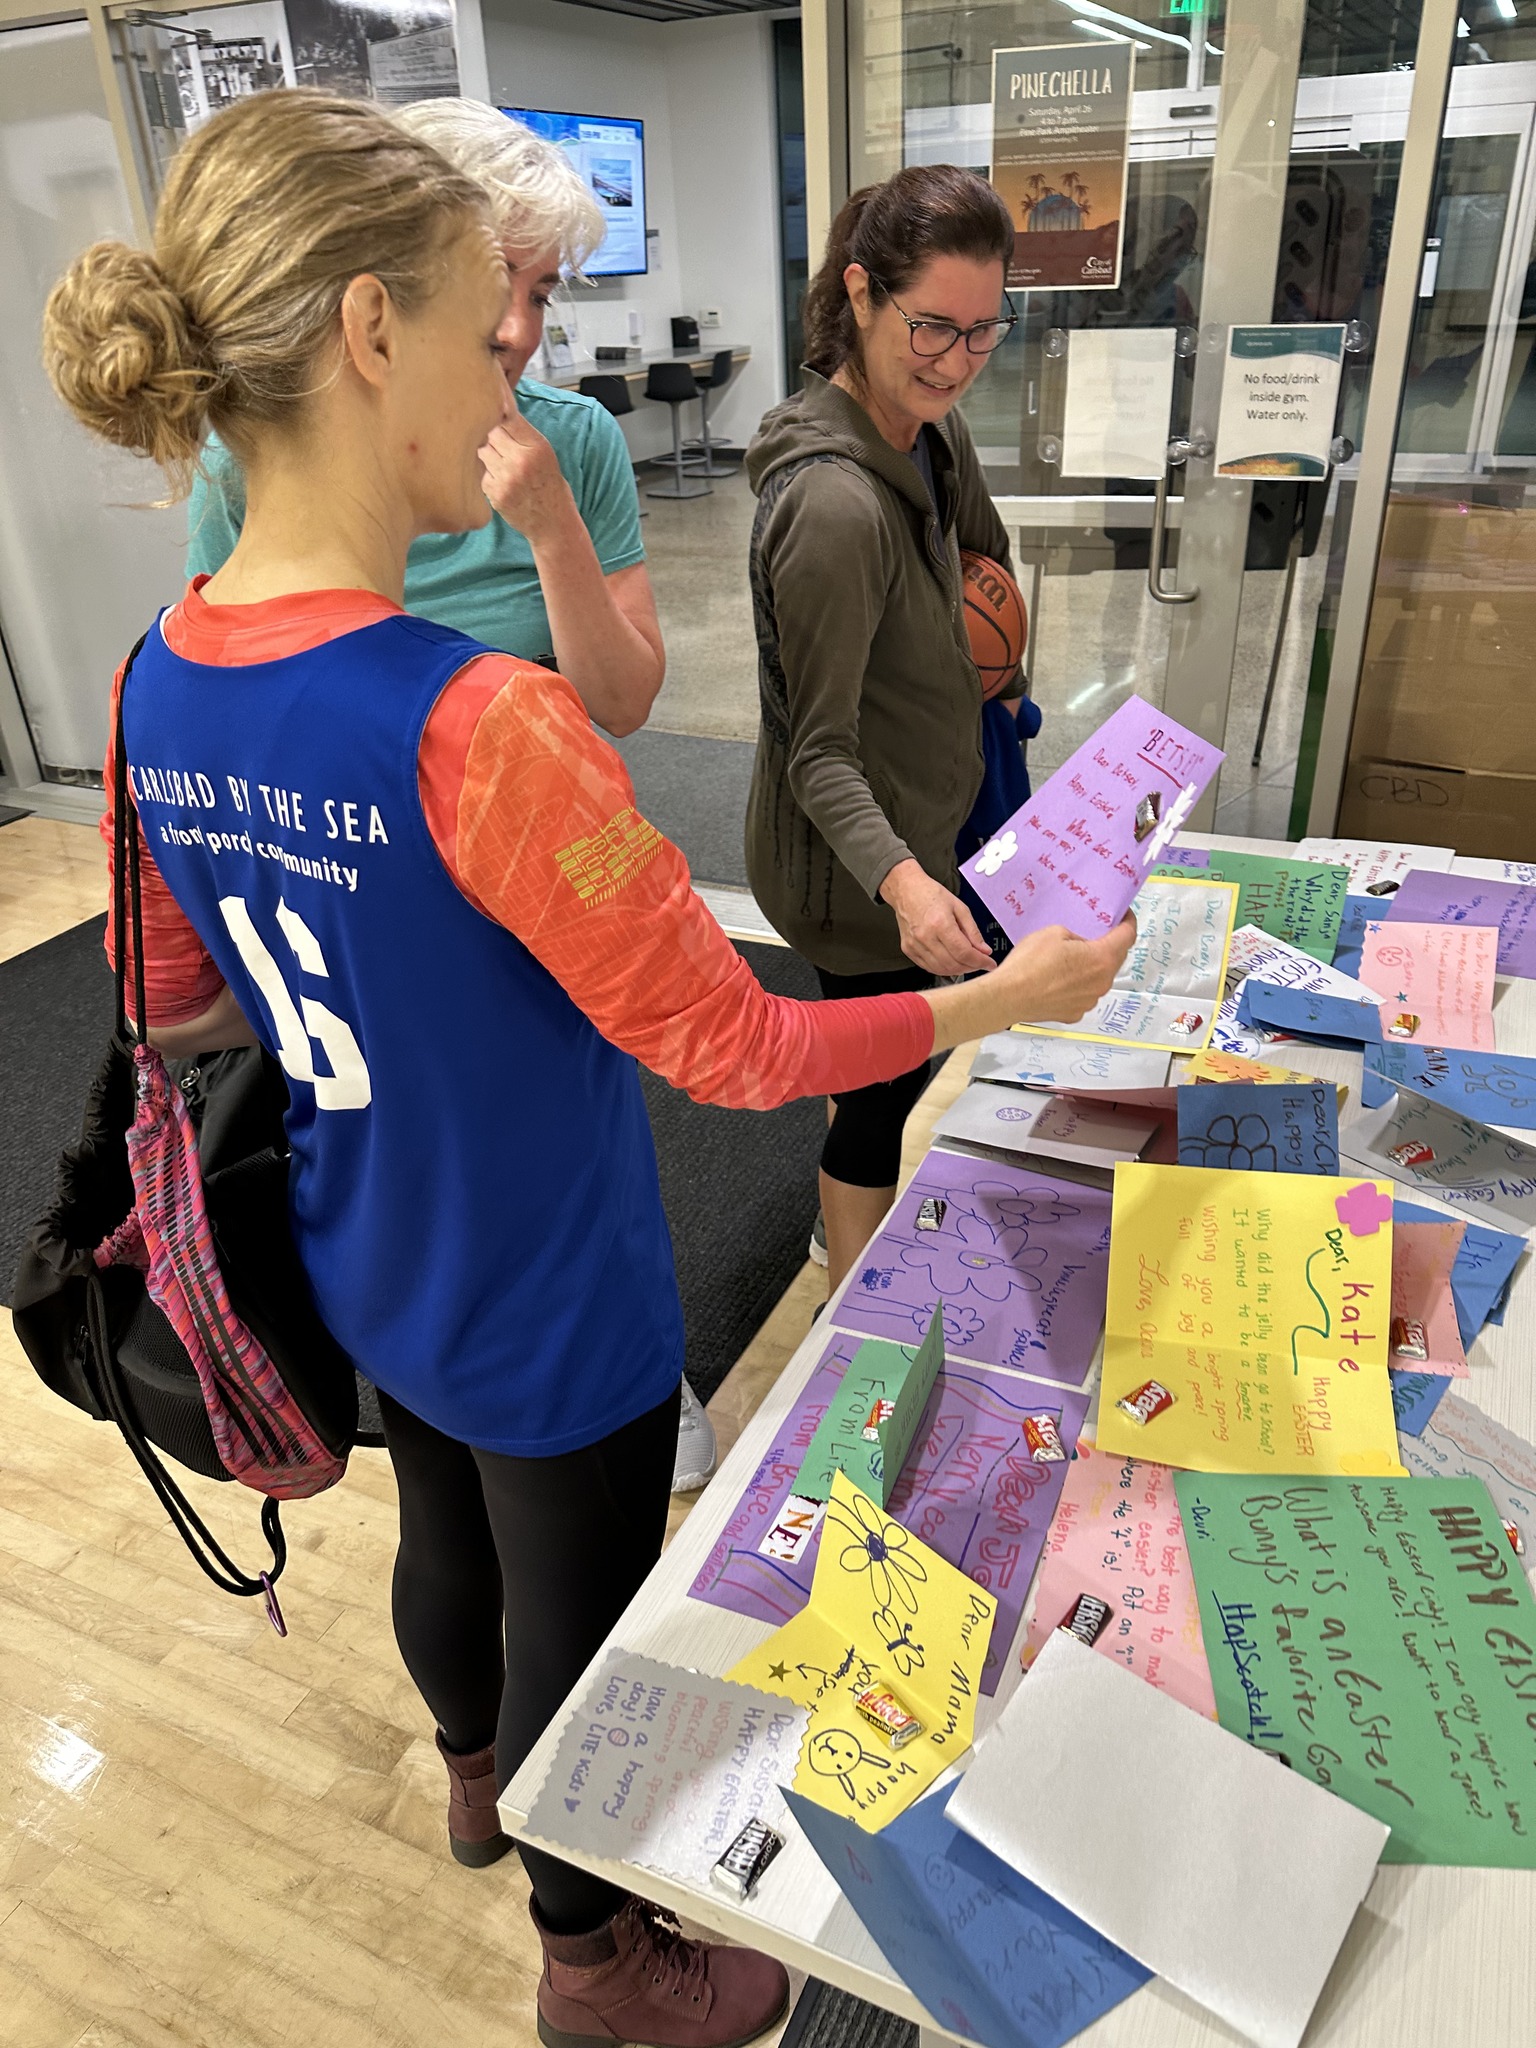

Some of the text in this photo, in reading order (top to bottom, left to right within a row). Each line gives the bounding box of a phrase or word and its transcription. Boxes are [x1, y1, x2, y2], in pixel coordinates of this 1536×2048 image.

[1010, 67, 1112, 99] PINECHELLA
[1243, 373, 1320, 386] No food/drink
[1249, 391, 1309, 405] inside gym.
[1246, 409, 1308, 422] Water only.
[227, 775, 252, 816] BY
[258, 784, 307, 833] THE
[323, 799, 390, 845] SEA
[160, 825, 169, 844] a
[561, 820, 631, 872] SPORT
[1304, 872, 1325, 905] Why
[1232, 1208, 1250, 1229] It
[1251, 1208, 1272, 1247] Why
[1257, 1251, 1275, 1275] did
[1181, 1273, 1198, 1292] of
[1195, 1276, 1213, 1306] you
[1257, 1280, 1270, 1304] the
[1239, 1304, 1252, 1321] to
[1325, 1228, 1377, 1374] Dear, Kate
[1178, 1310, 1198, 1334] joy
[1201, 1321, 1215, 1339] a
[1253, 1311, 1275, 1342] jelly
[1239, 1334, 1251, 1348] be
[1241, 1360, 1251, 1369] a
[843, 1376, 887, 1437] From
[1211, 1398, 1230, 1442] spring
[1307, 1376, 1333, 1432] Happy
[1292, 1404, 1316, 1458] EASTER
[819, 1442, 857, 1485] Lite
[747, 1462, 800, 1517] Bryce
[1376, 1485, 1408, 1523] Happy
[1113, 1499, 1133, 1520] the
[1049, 1500, 1081, 1554] Helena
[1228, 1495, 1299, 1588] Bunny's
[1161, 1545, 1180, 1577] best
[1396, 1531, 1435, 1582] Easter
[1429, 1506, 1519, 1607] HAPPY
[1122, 1585, 1145, 1611] Put
[1148, 1584, 1170, 1616] way
[1118, 1618, 1133, 1636] an
[1151, 1626, 1174, 1644] to
[1282, 1486, 1415, 1809] What is an Easter
[1363, 1543, 1393, 1569] you
[1425, 1680, 1441, 1701] to
[1449, 1750, 1462, 1765] a
[1434, 1634, 1457, 1655] I
[931, 1593, 992, 1745] Dear Mama
[1445, 1660, 1466, 1688] can
[619, 1680, 647, 1723] day!
[567, 1674, 628, 1794] Love, LITE Kids
[765, 1711, 796, 1754] Dear
[602, 1684, 668, 1821] Have a hoppy
[704, 1706, 765, 1858] HAPPY EASTER!
[858, 1760, 919, 1811] happy
